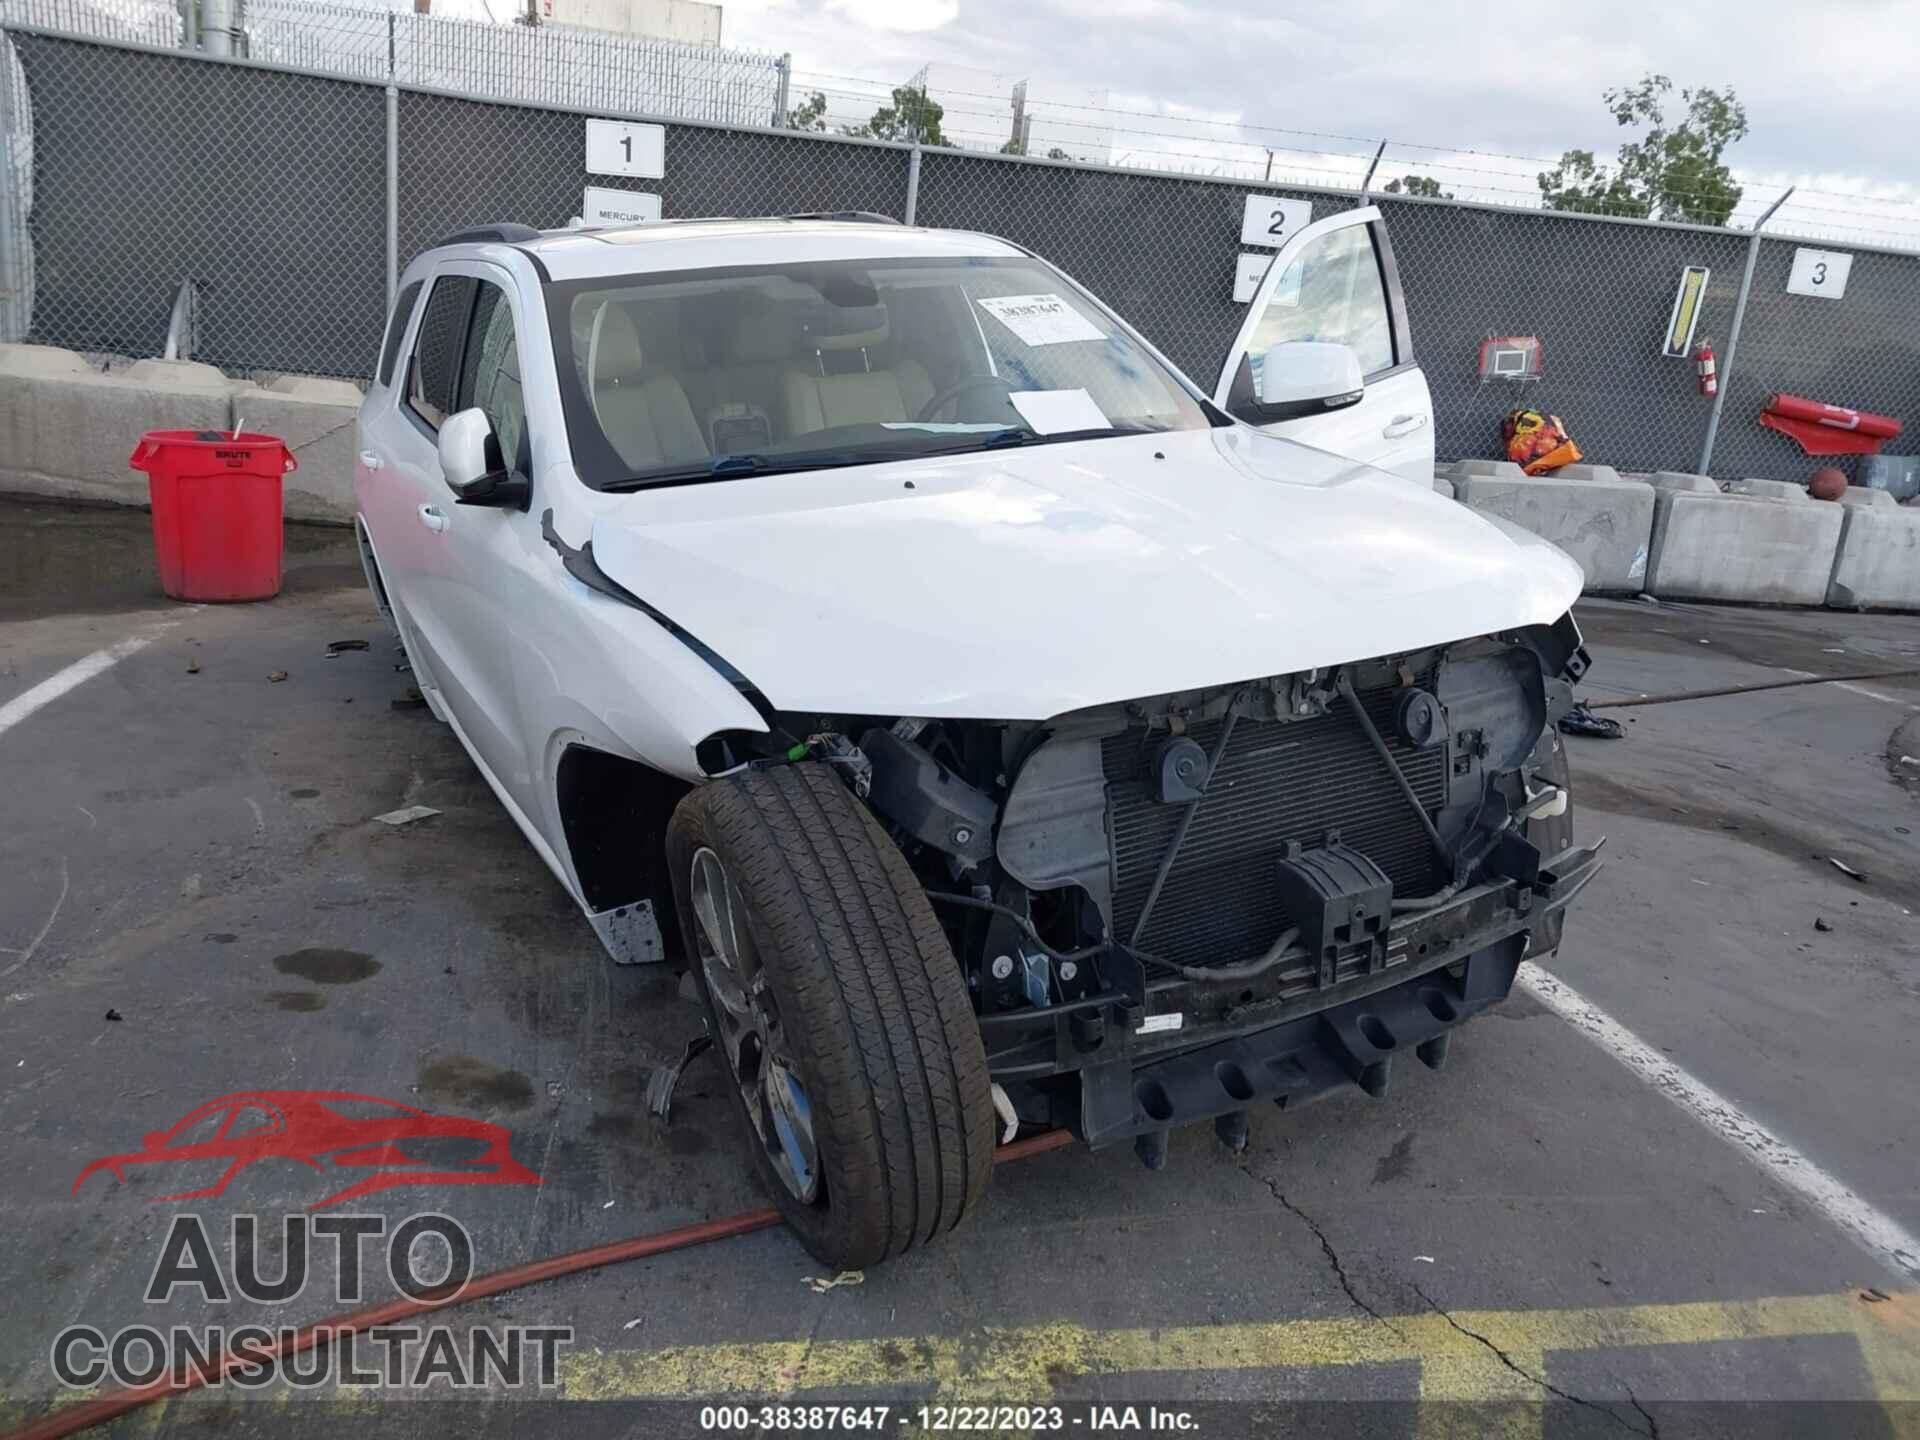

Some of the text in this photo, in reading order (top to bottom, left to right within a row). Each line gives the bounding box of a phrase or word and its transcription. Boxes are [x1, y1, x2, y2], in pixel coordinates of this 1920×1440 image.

[620, 136, 632, 163] 1
[599, 210, 646, 221] MERCURY
[1267, 210, 1286, 235] 2
[1812, 262, 1827, 285] 3
